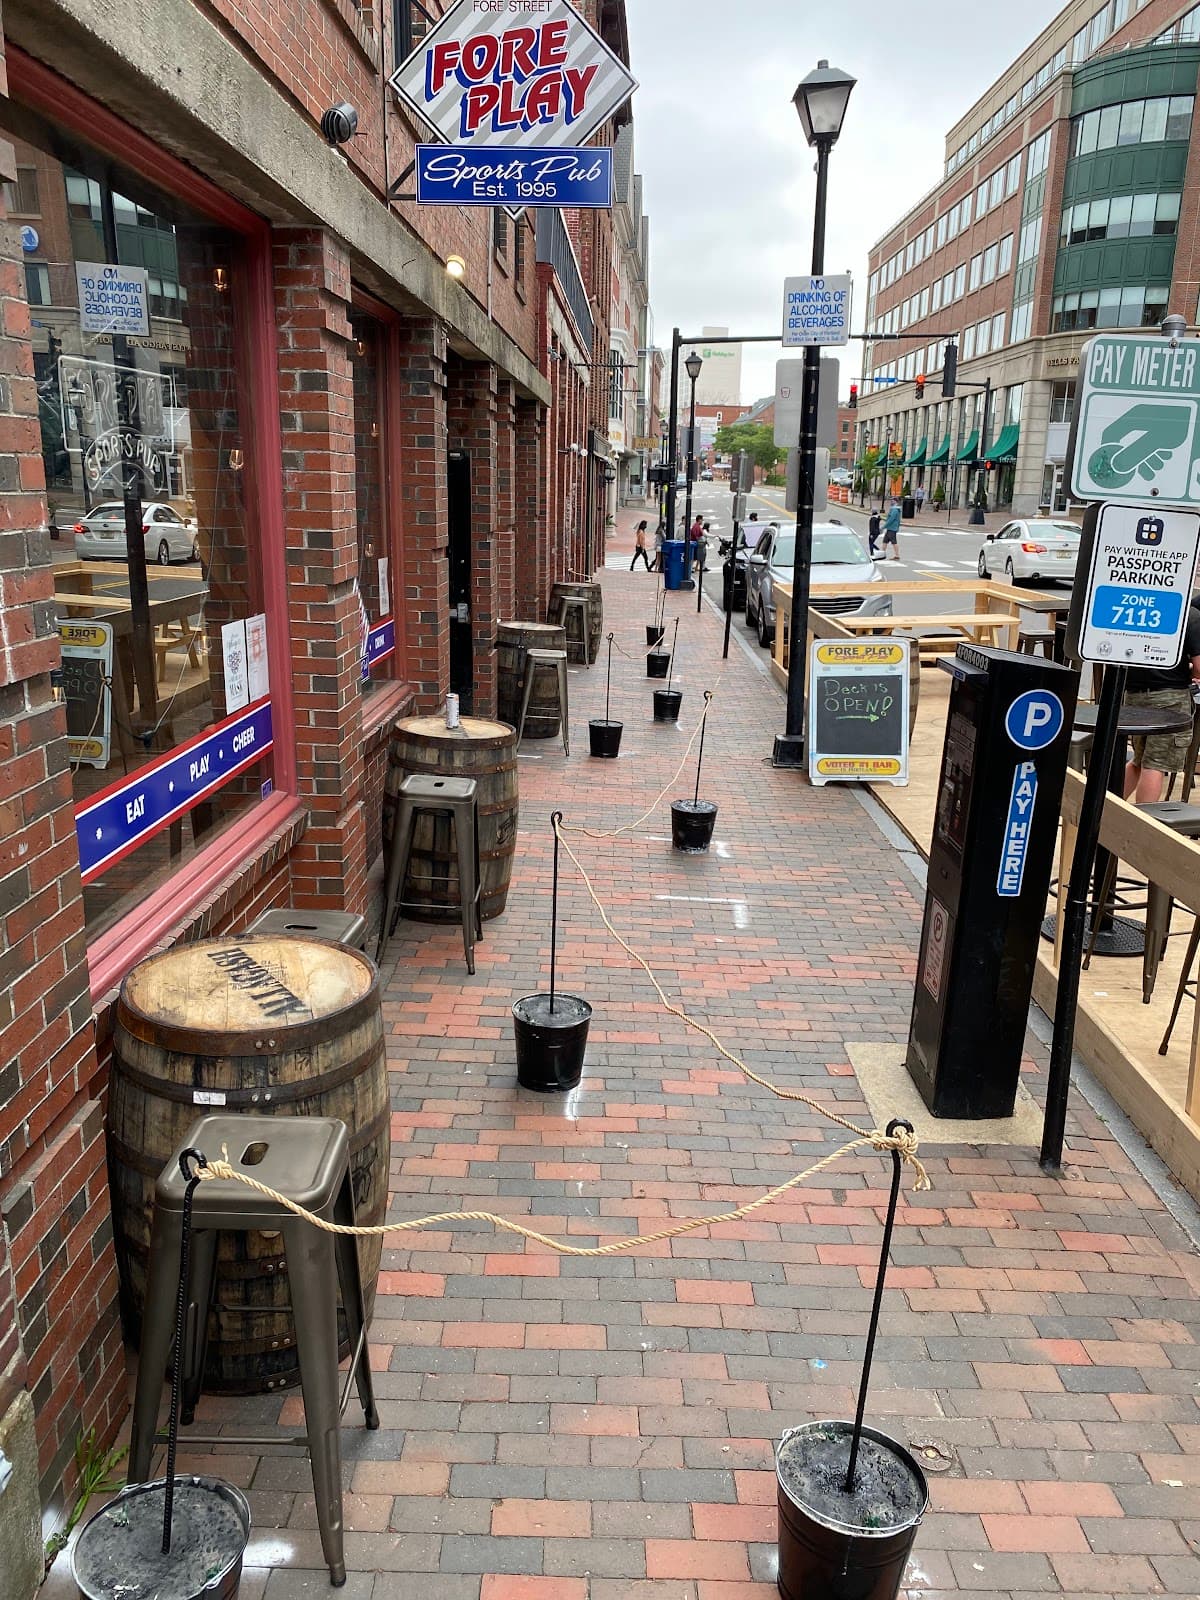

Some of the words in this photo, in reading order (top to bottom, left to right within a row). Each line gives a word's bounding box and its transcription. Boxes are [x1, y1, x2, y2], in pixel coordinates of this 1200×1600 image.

[473, 0, 503, 13] FORE
[508, 0, 551, 13] STREET
[426, 20, 569, 101] FORE
[461, 65, 599, 137] PLAY
[424, 154, 528, 188] Sports
[531, 156, 602, 182] Pub
[473, 182, 507, 197] Est.
[516, 182, 557, 197] 1995
[811, 279, 825, 290] NO
[788, 292, 831, 304] DRINKING
[833, 291, 846, 302] OF
[790, 304, 844, 316] ALCOHOLIC
[788, 317, 844, 329] BEVERAGES
[1090, 344, 1127, 384] PAY
[1131, 346, 1196, 388] METER
[1104, 545, 1123, 554] PAY
[1123, 546, 1149, 557] WITH
[1150, 549, 1168, 559] THE
[1169, 551, 1189, 561] APP
[1107, 555, 1182, 574] PASSPORT
[1109, 569, 1175, 587] PARKING
[1121, 593, 1157, 608] ZONE
[1111, 606, 1162, 628] 7113
[828, 647, 859, 656] FORE
[865, 647, 894, 656] PLAY
[823, 679, 868, 696] Deck
[1022, 702, 1053, 737] P
[825, 761, 855, 769] VOTED
[872, 761, 893, 769] BAR
[126, 793, 145, 825] EAT
[189, 752, 210, 782] PLAY
[232, 725, 256, 753] CHEER
[1015, 760, 1037, 815] PAY
[1001, 821, 1028, 890] HERE
